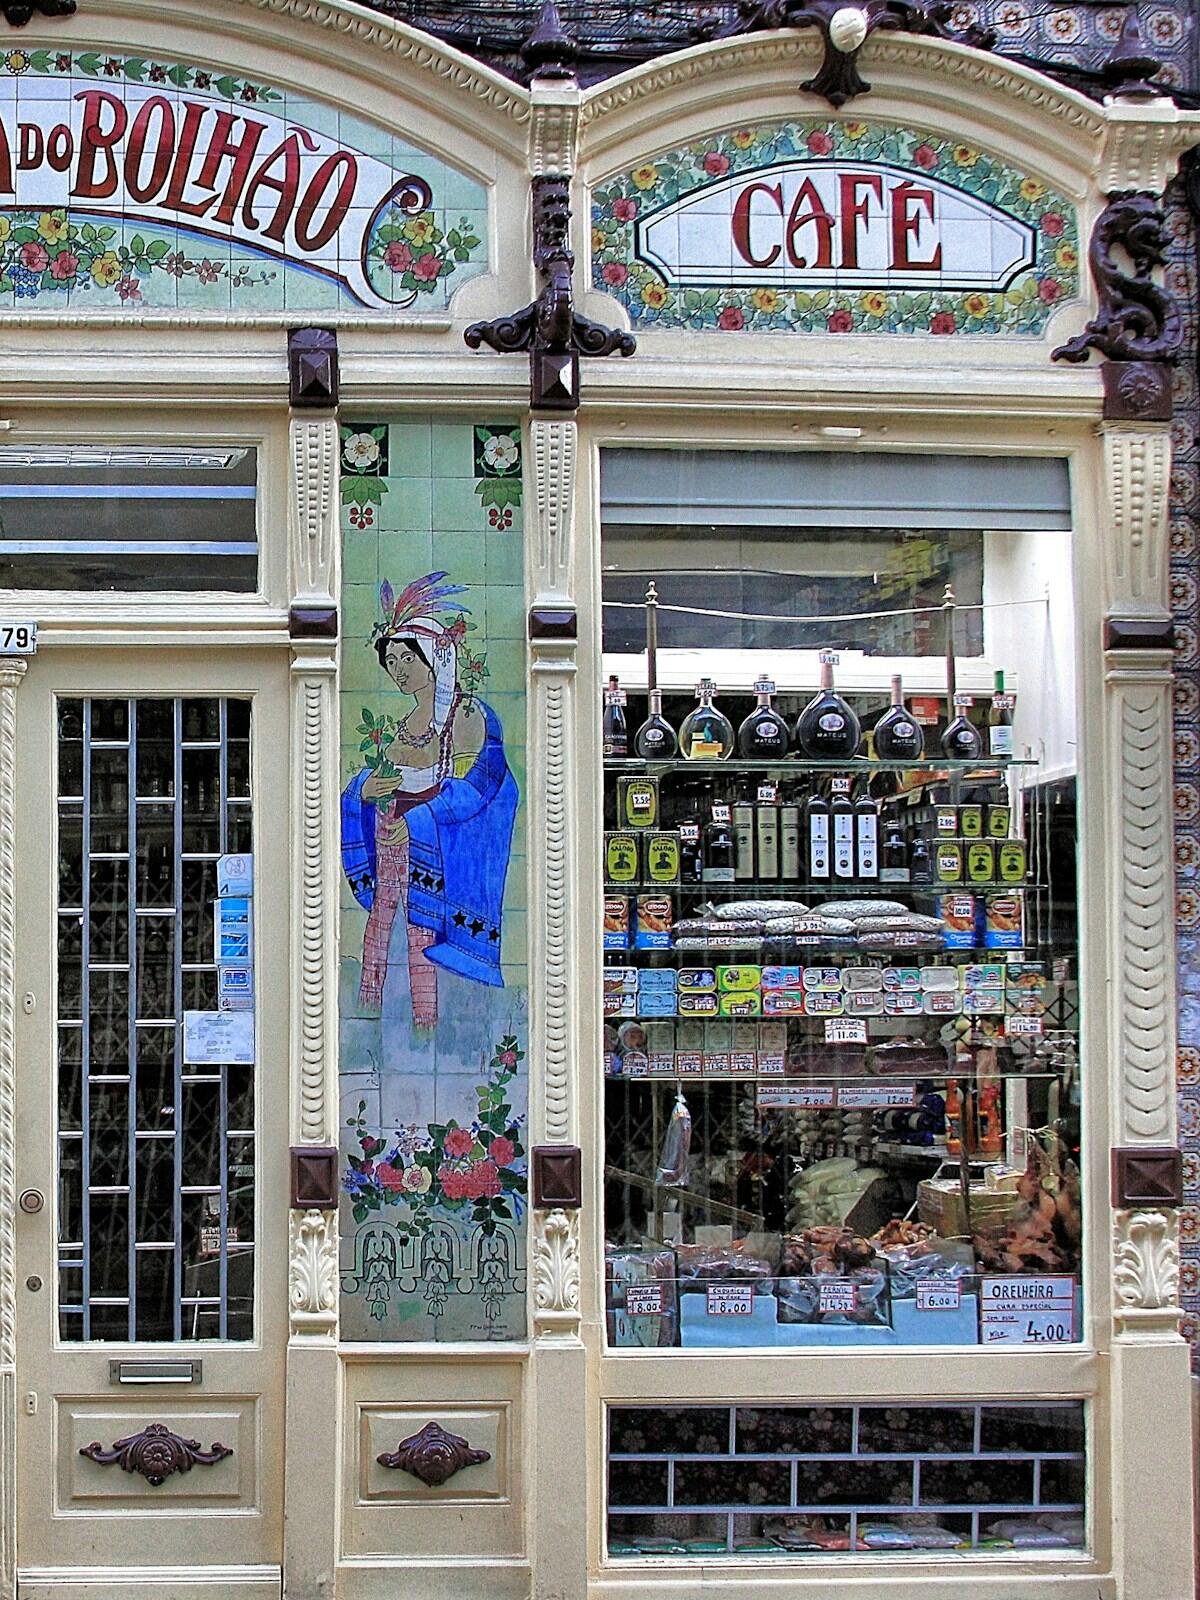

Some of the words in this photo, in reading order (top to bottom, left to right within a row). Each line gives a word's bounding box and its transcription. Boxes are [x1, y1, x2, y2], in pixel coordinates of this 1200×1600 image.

[17, 123, 71, 172] DO
[69, 88, 359, 252] BOLHÃO
[731, 173, 942, 271] CAFÉ
[719, 1301, 747, 1313] 8.00
[992, 1281, 1054, 1298] ORELHEIRA
